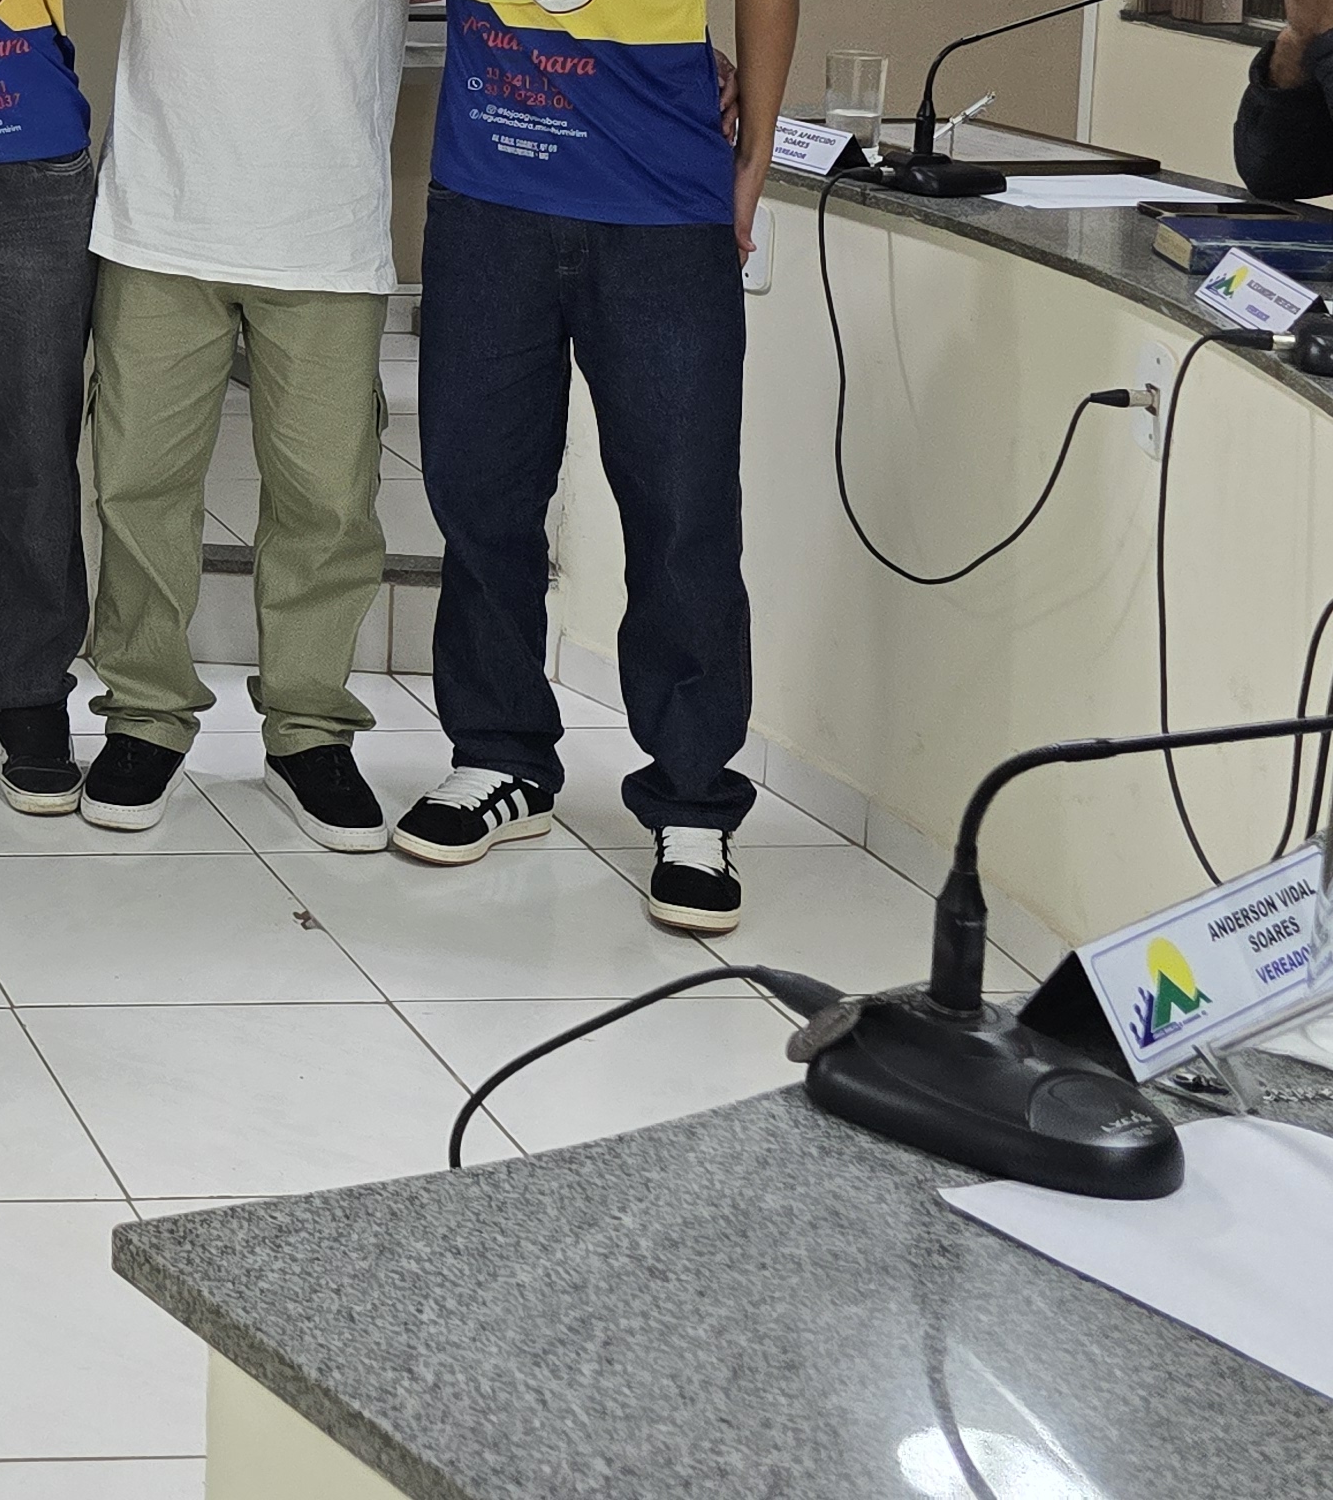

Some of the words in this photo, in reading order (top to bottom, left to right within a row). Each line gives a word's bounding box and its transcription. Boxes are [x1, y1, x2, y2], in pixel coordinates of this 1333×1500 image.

[782, 136, 811, 149] SOARES
[1206, 893, 1278, 942] ANDERSON
[1274, 878, 1316, 908] VIDAL
[1247, 915, 1302, 953] SOARES
